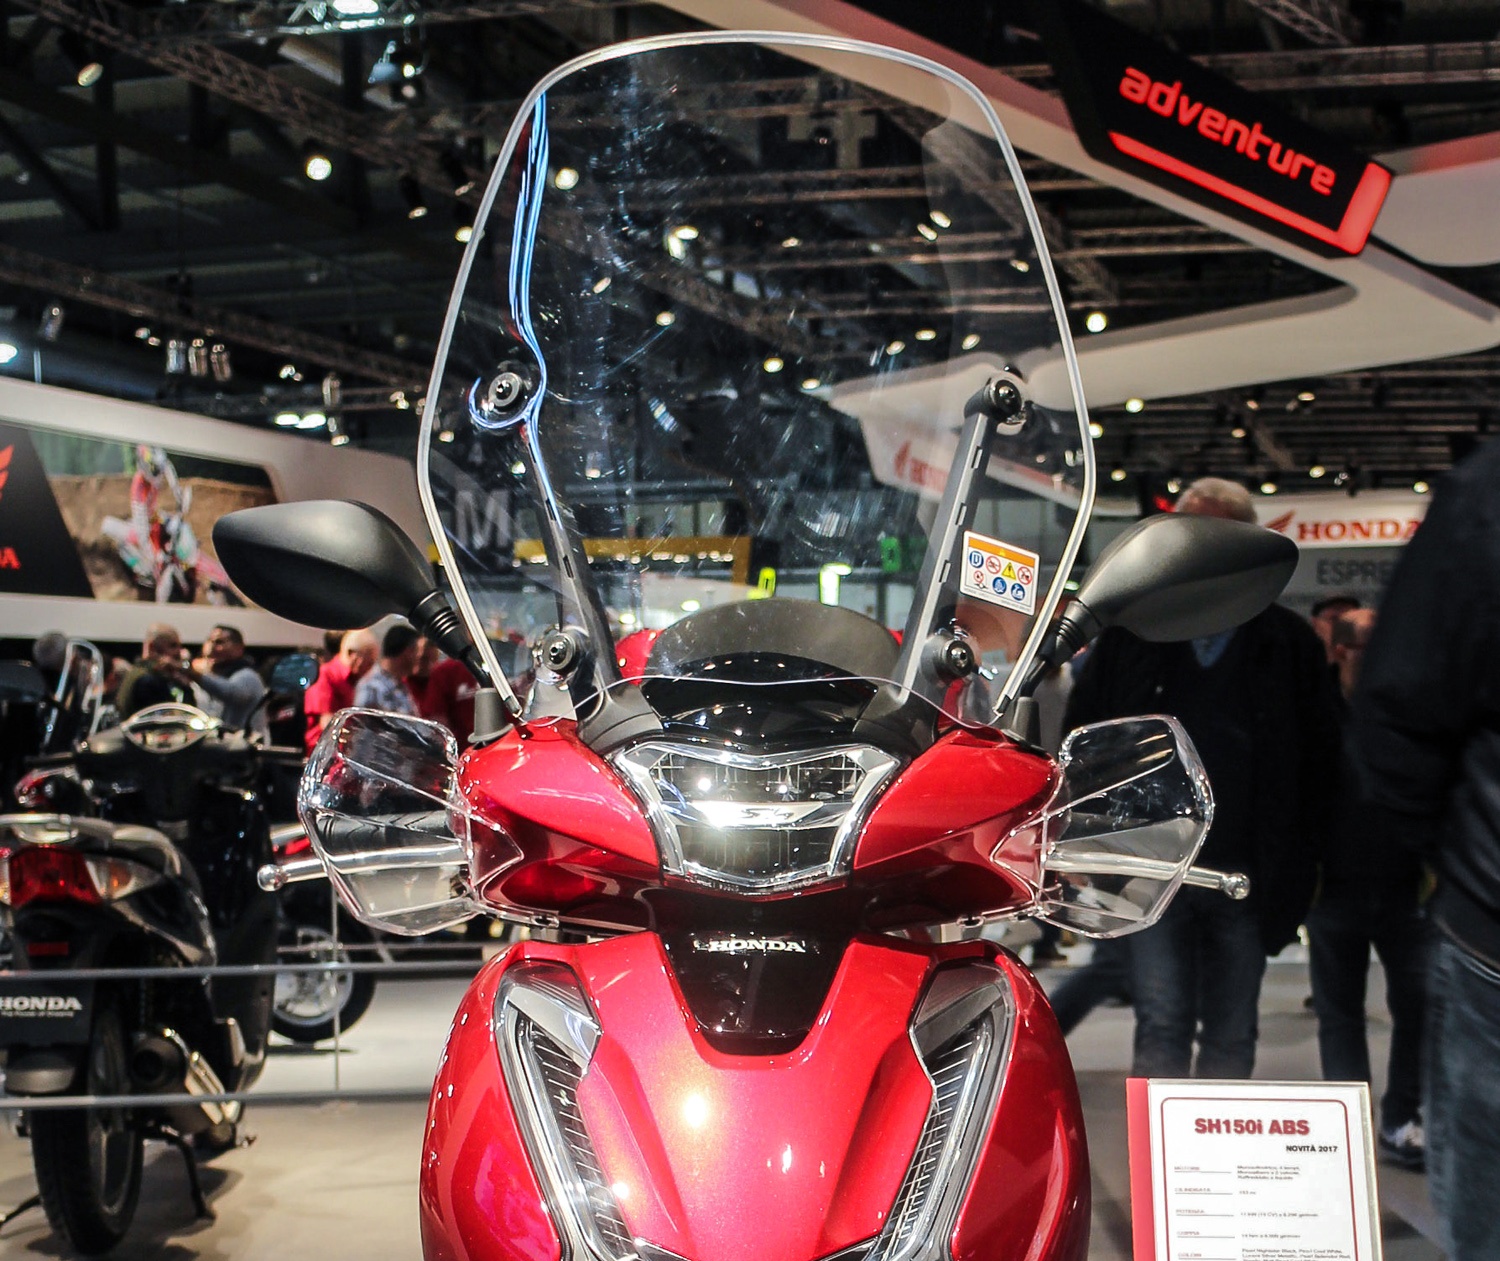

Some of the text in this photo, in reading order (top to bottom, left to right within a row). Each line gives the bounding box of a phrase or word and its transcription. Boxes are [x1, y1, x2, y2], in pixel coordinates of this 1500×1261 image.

[1118, 65, 1336, 196] adventure
[708, 939, 806, 953] HONDA
[0, 996, 82, 1010] HONDA
[1194, 1118, 1310, 1135] SH150i ABS
[1286, 1144, 1338, 1153] NOVITÀ 2017
